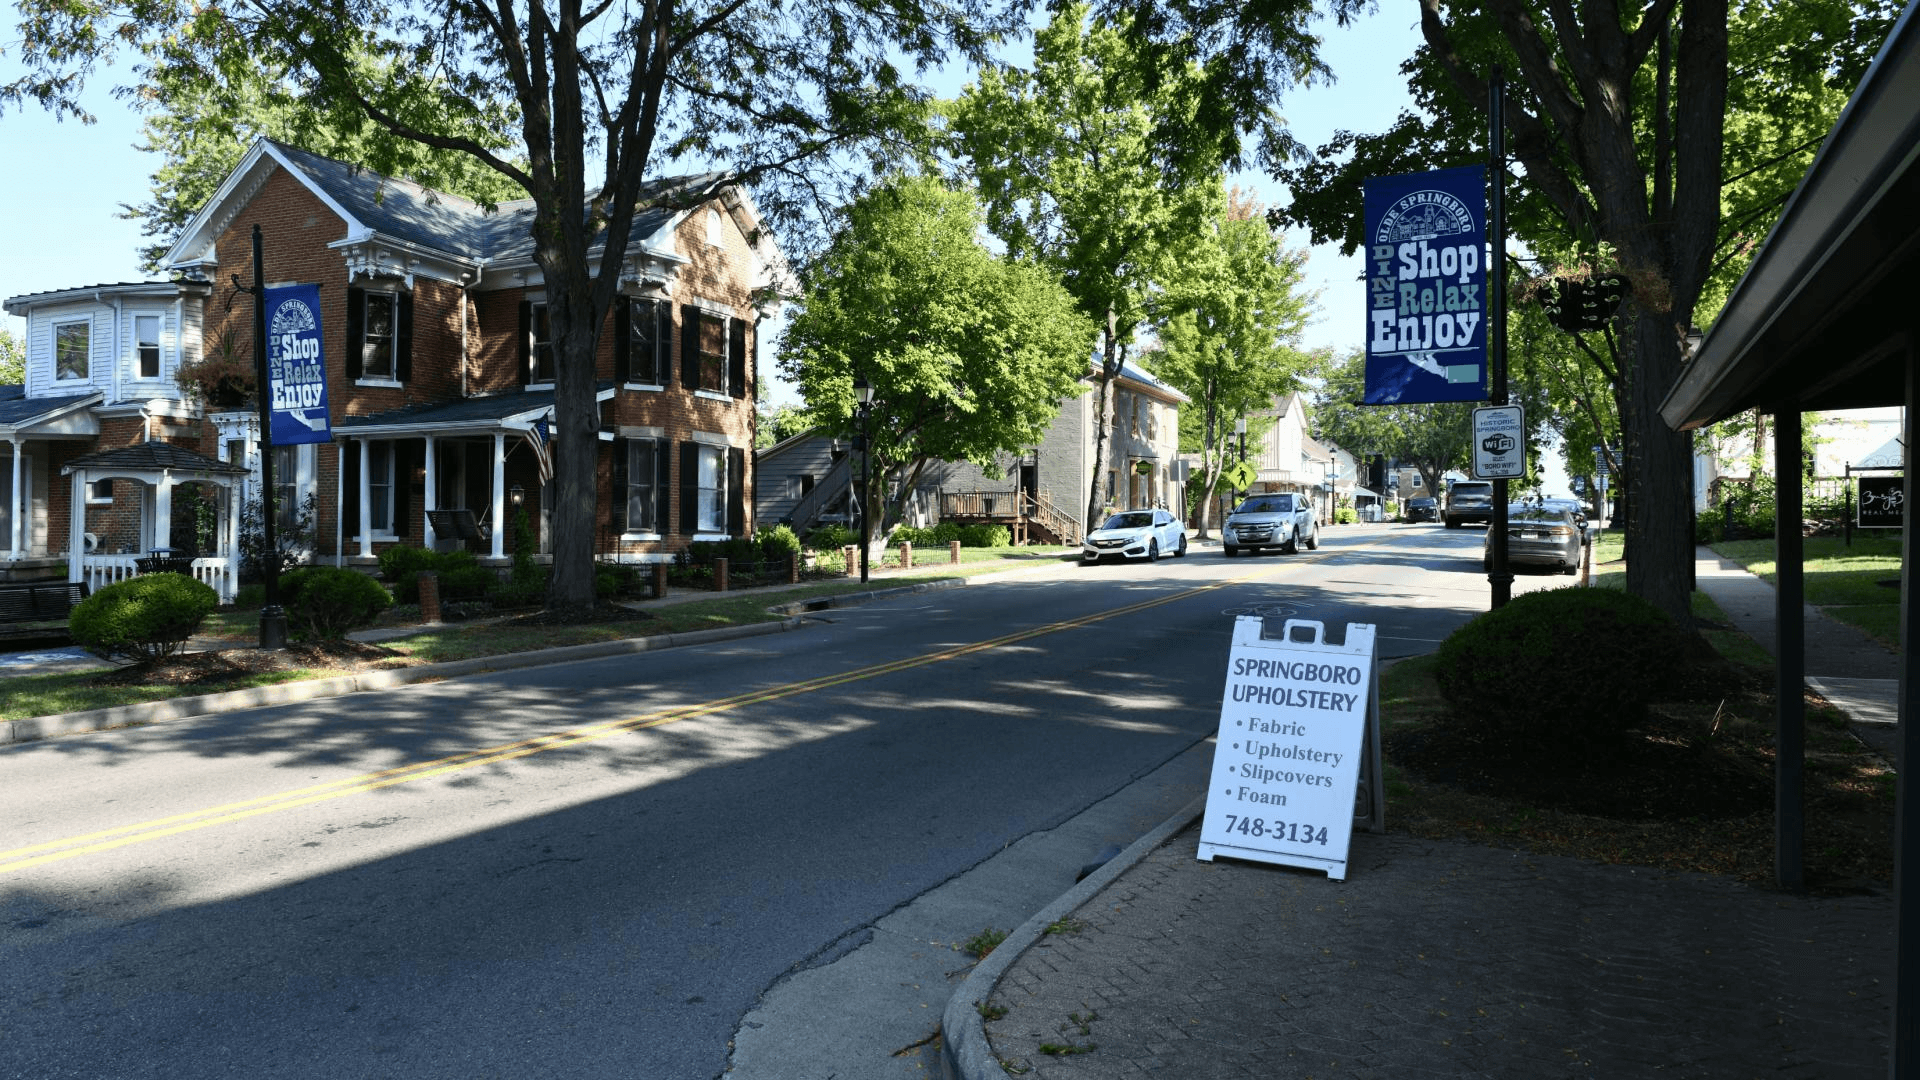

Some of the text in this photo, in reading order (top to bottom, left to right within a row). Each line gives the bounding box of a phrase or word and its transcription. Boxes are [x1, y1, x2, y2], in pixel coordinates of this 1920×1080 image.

[1379, 192, 1472, 242] OLDE SPRINGBORO
[1372, 245, 1397, 309] DINE
[1398, 241, 1478, 284] Shop
[1399, 279, 1480, 317] Relax
[1371, 308, 1480, 353] Enjoy
[270, 336, 283, 379] DINE
[282, 334, 319, 364] Shop
[284, 361, 322, 385] Relax
[271, 379, 323, 410] Enjoy
[1233, 658, 1362, 686] SPRINGBORO
[1232, 684, 1359, 712] UPHOLSTERY
[1248, 717, 1306, 737] Fabric
[1245, 740, 1343, 768] Upholstery
[1240, 763, 1333, 788] Slipcovers
[1237, 786, 1287, 806] Foam
[1225, 814, 1329, 846] 748-3134
